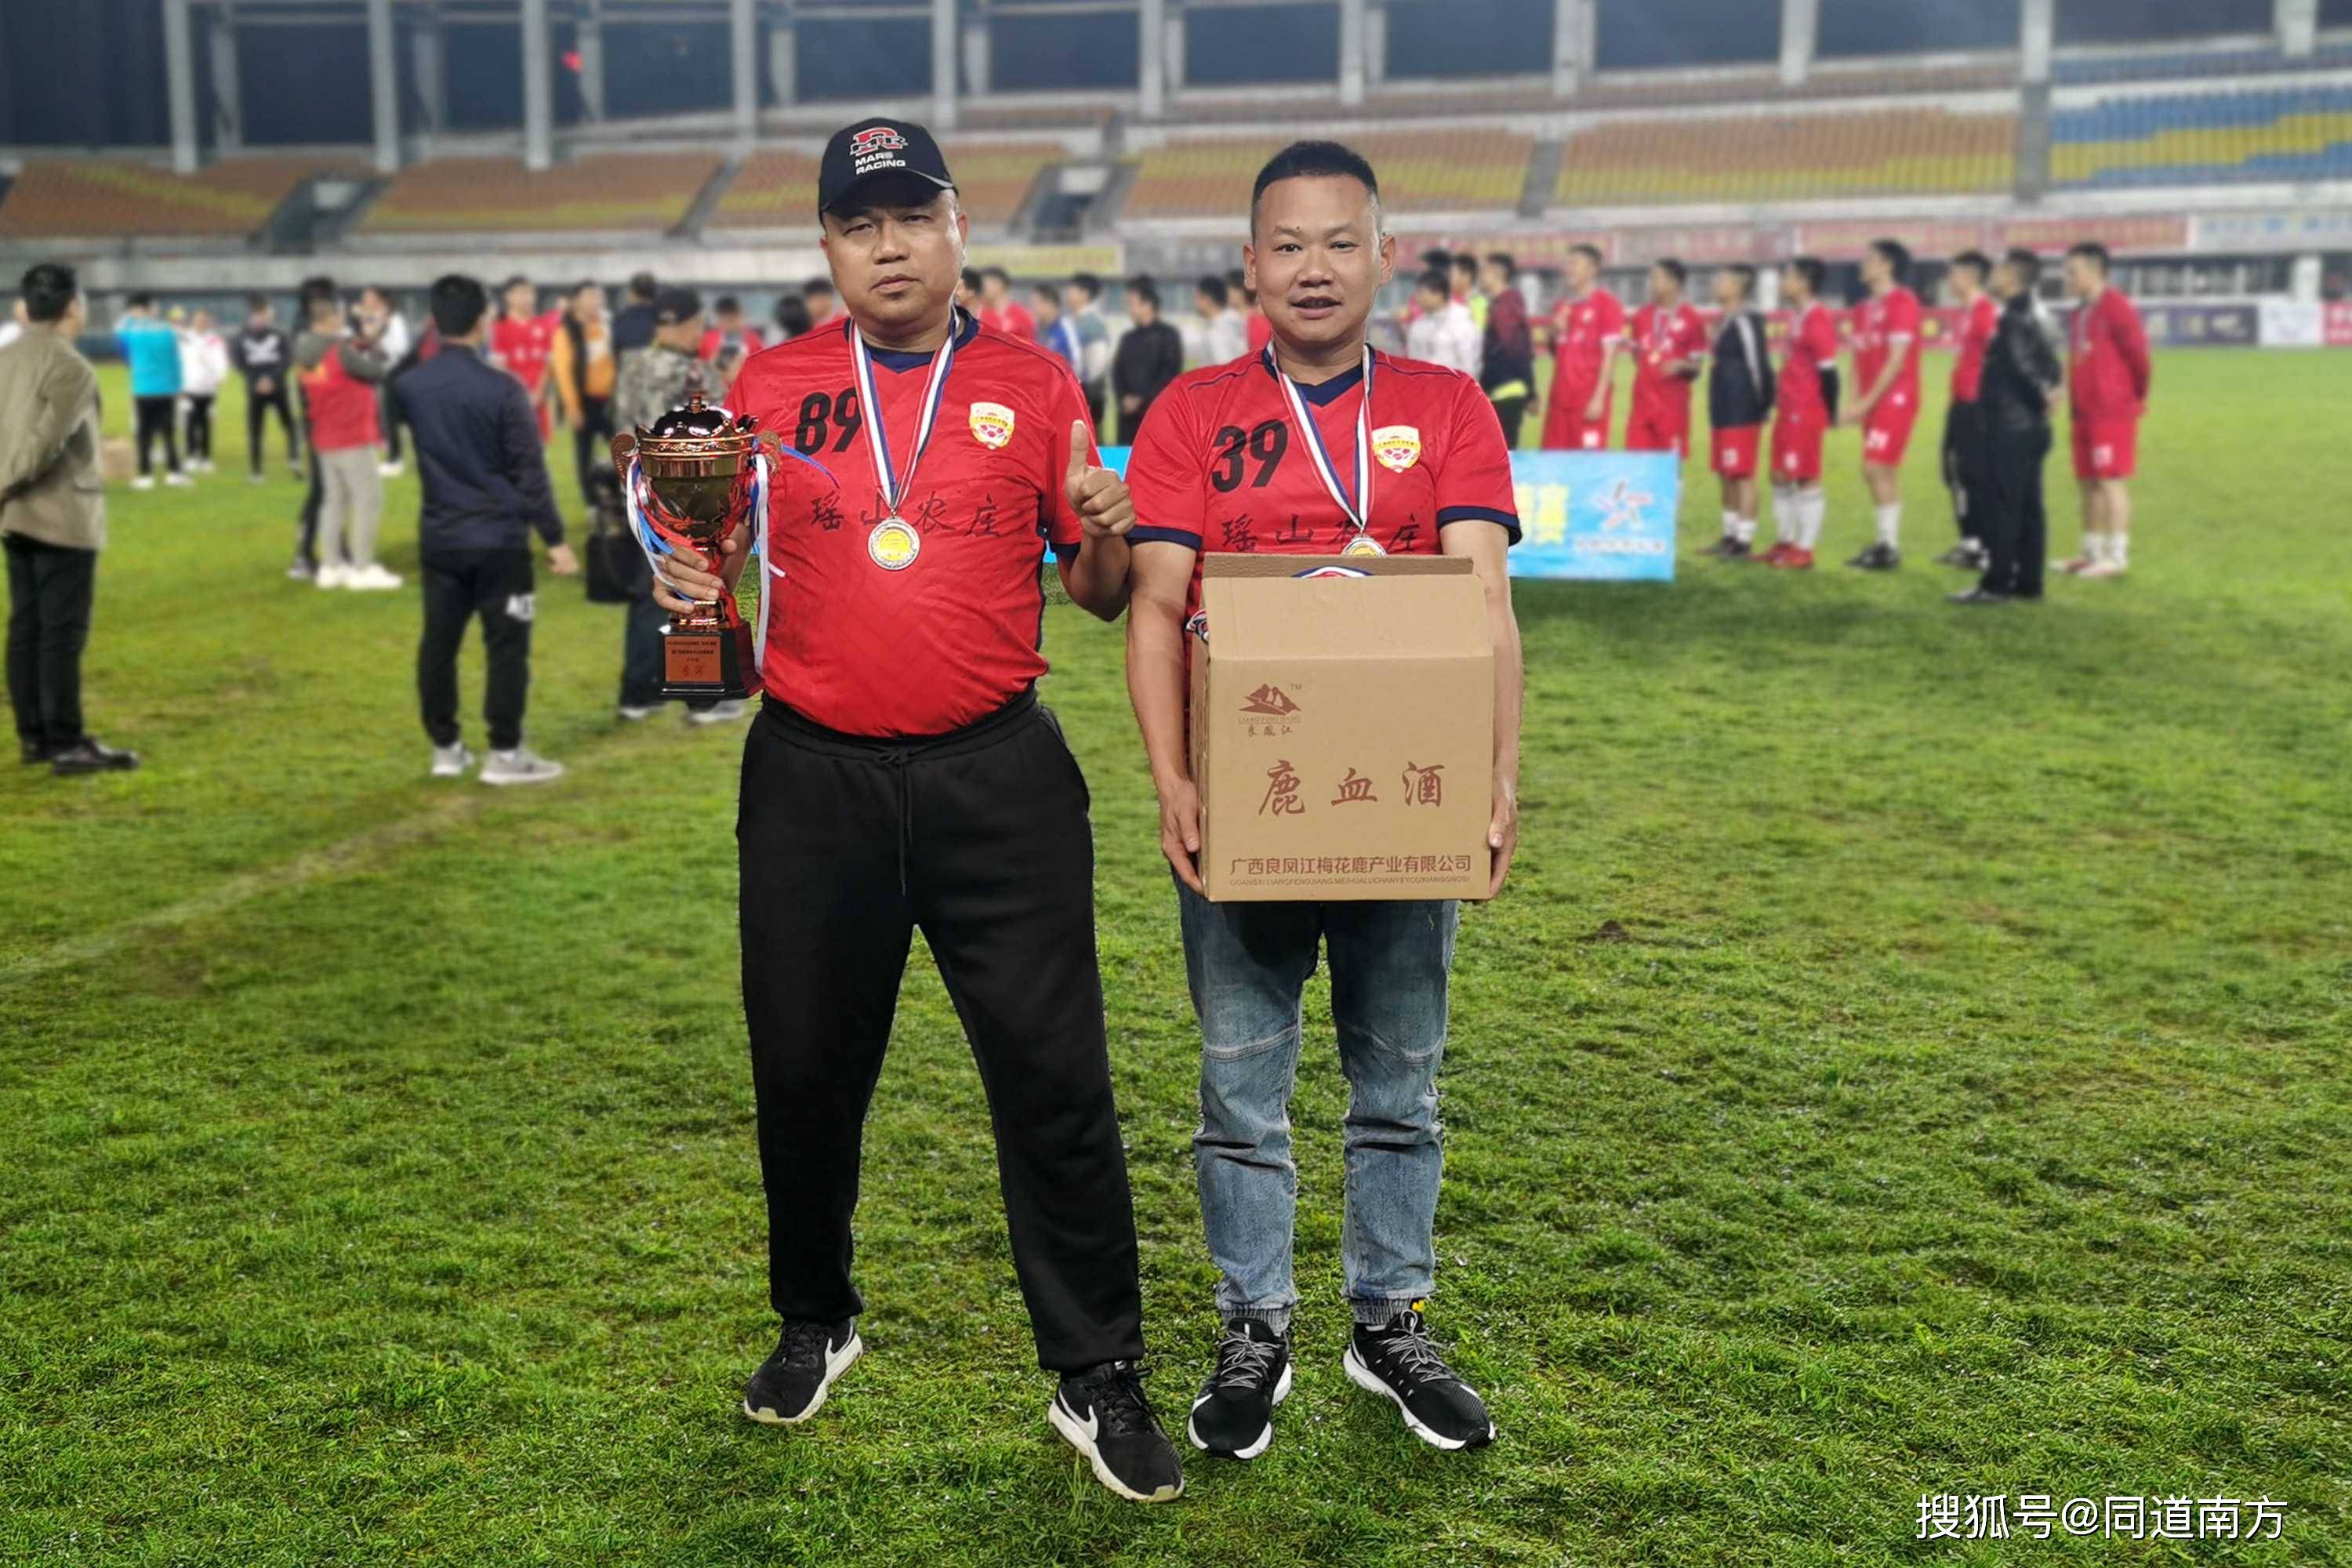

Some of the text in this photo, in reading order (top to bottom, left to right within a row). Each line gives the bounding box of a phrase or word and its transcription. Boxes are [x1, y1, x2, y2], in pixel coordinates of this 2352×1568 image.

[856, 159, 906, 175] RACING
[794, 387, 862, 456] 89
[1211, 419, 1288, 492] 39
[1258, 759, 1444, 815] 鹿血酒
[1230, 854, 1471, 876] 广西良凤江梅花鹿产业有限公司
